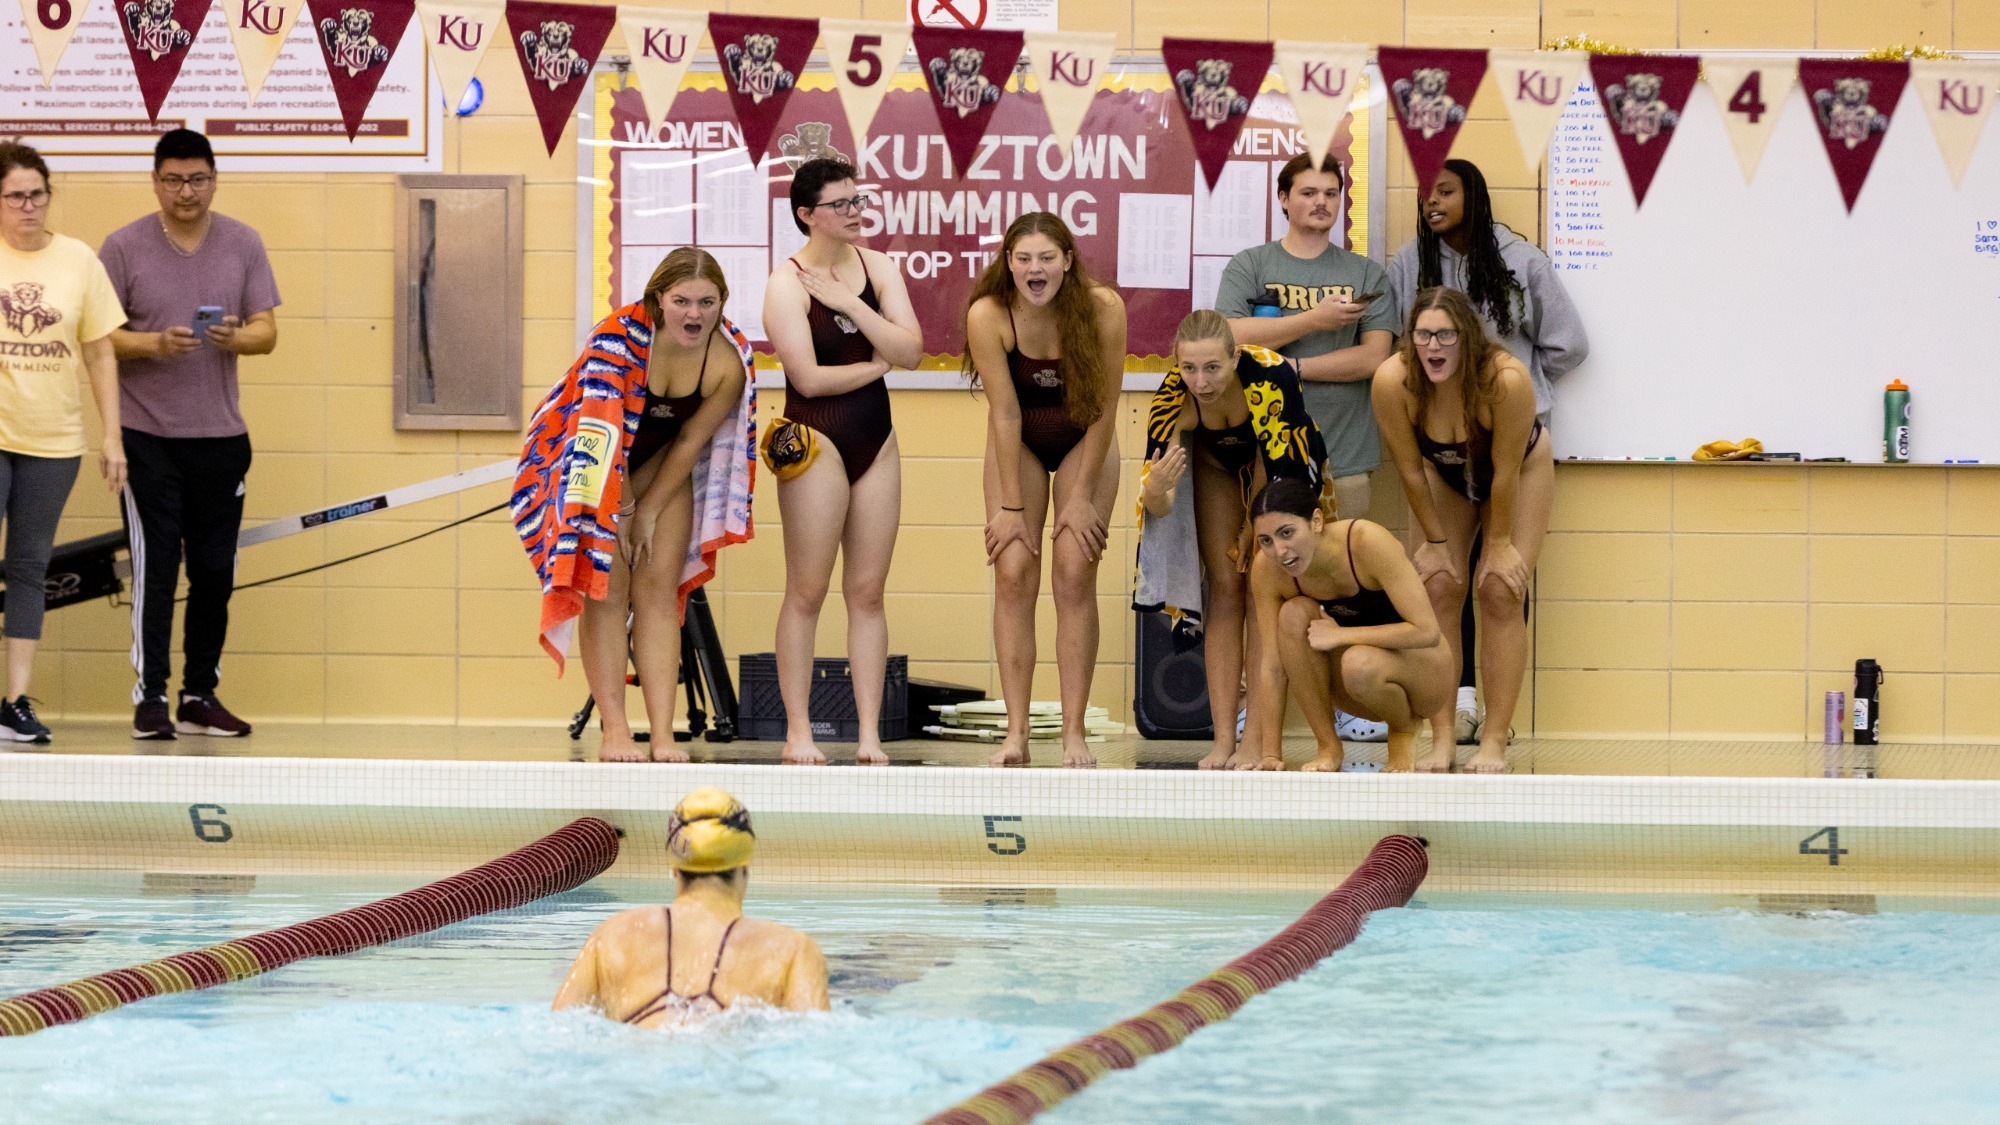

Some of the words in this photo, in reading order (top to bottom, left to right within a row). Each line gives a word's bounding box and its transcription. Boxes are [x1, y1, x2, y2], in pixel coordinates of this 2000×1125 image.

[239, 0, 286, 35] KU
[138, 26, 172, 53] KU
[437, 15, 483, 51] KU
[642, 27, 688, 63] KU
[219, 53, 235, 61] lap
[336, 40, 369, 69] KU
[846, 35, 882, 87] 5
[1049, 50, 1094, 86] KU
[535, 55, 570, 84] KU
[738, 64, 776, 97] KU
[1303, 61, 1346, 97] KU
[122, 83, 133, 91] of
[261, 84, 323, 93] responsible
[943, 82, 981, 110] KU
[1517, 69, 1562, 106] KU
[1728, 71, 1766, 123] 4
[1939, 79, 1983, 115] KU
[89, 100, 133, 109] capacity
[168, 100, 209, 109] patrons
[212, 100, 247, 109] during
[64, 123, 111, 131] SERVICES
[235, 123, 271, 131] PUBLIC
[273, 123, 308, 131] SAFETY
[858, 135, 1146, 181] KUTZTOWN
[1555, 223, 1560, 231] 9
[1975, 234, 1999, 243] Sara
[889, 251, 952, 279] TOP
[0, 340, 72, 359] TZTOWN
[0, 360, 61, 372] IMMING
[327, 500, 377, 522] trainer
[189, 803, 233, 842] 6
[983, 815, 1026, 855] 5
[1799, 827, 1848, 866] 4
